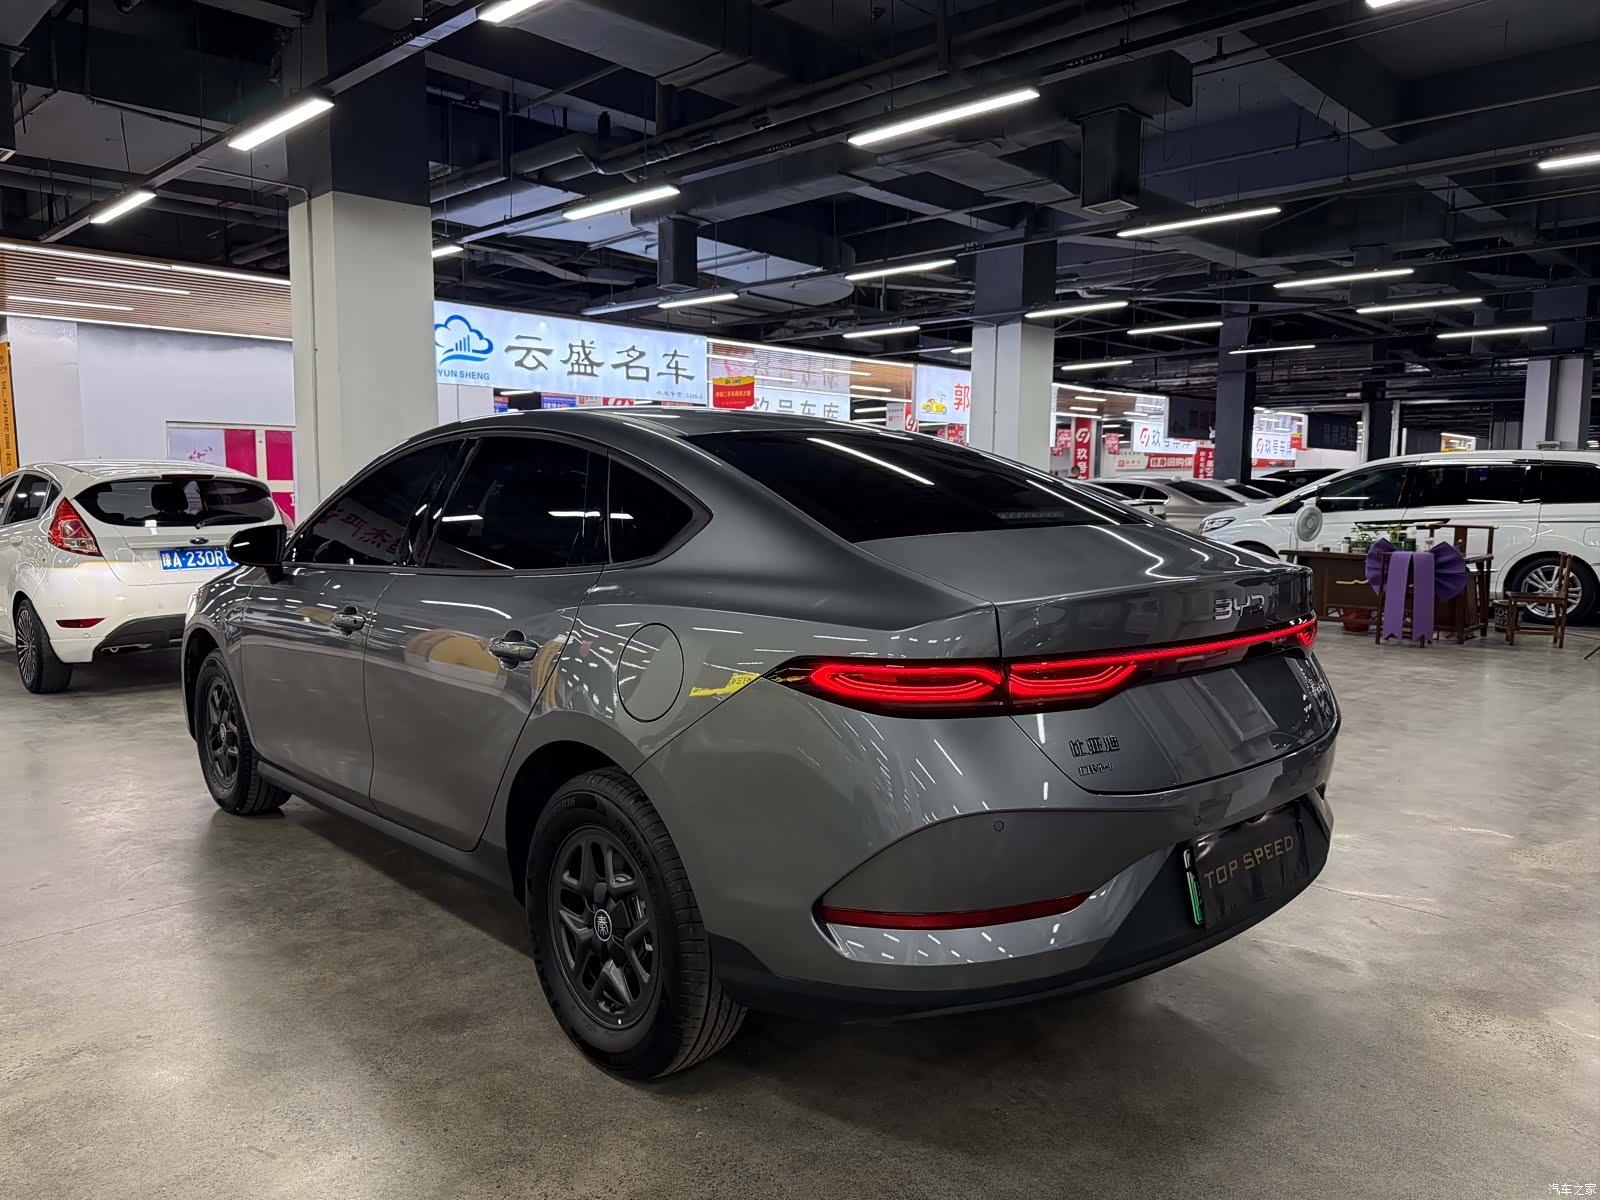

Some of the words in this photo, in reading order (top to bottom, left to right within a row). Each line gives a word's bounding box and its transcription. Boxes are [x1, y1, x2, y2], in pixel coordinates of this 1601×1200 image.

[504, 335, 695, 385] 云盛名车
[438, 369, 458, 379] YUN
[459, 370, 491, 381] SHENG
[954, 383, 971, 413] 郭
[1213, 594, 1265, 621] BYD
[1068, 736, 1120, 757] 比亚迪
[1204, 859, 1238, 889] TOP
[1242, 835, 1294, 871] SPEED
